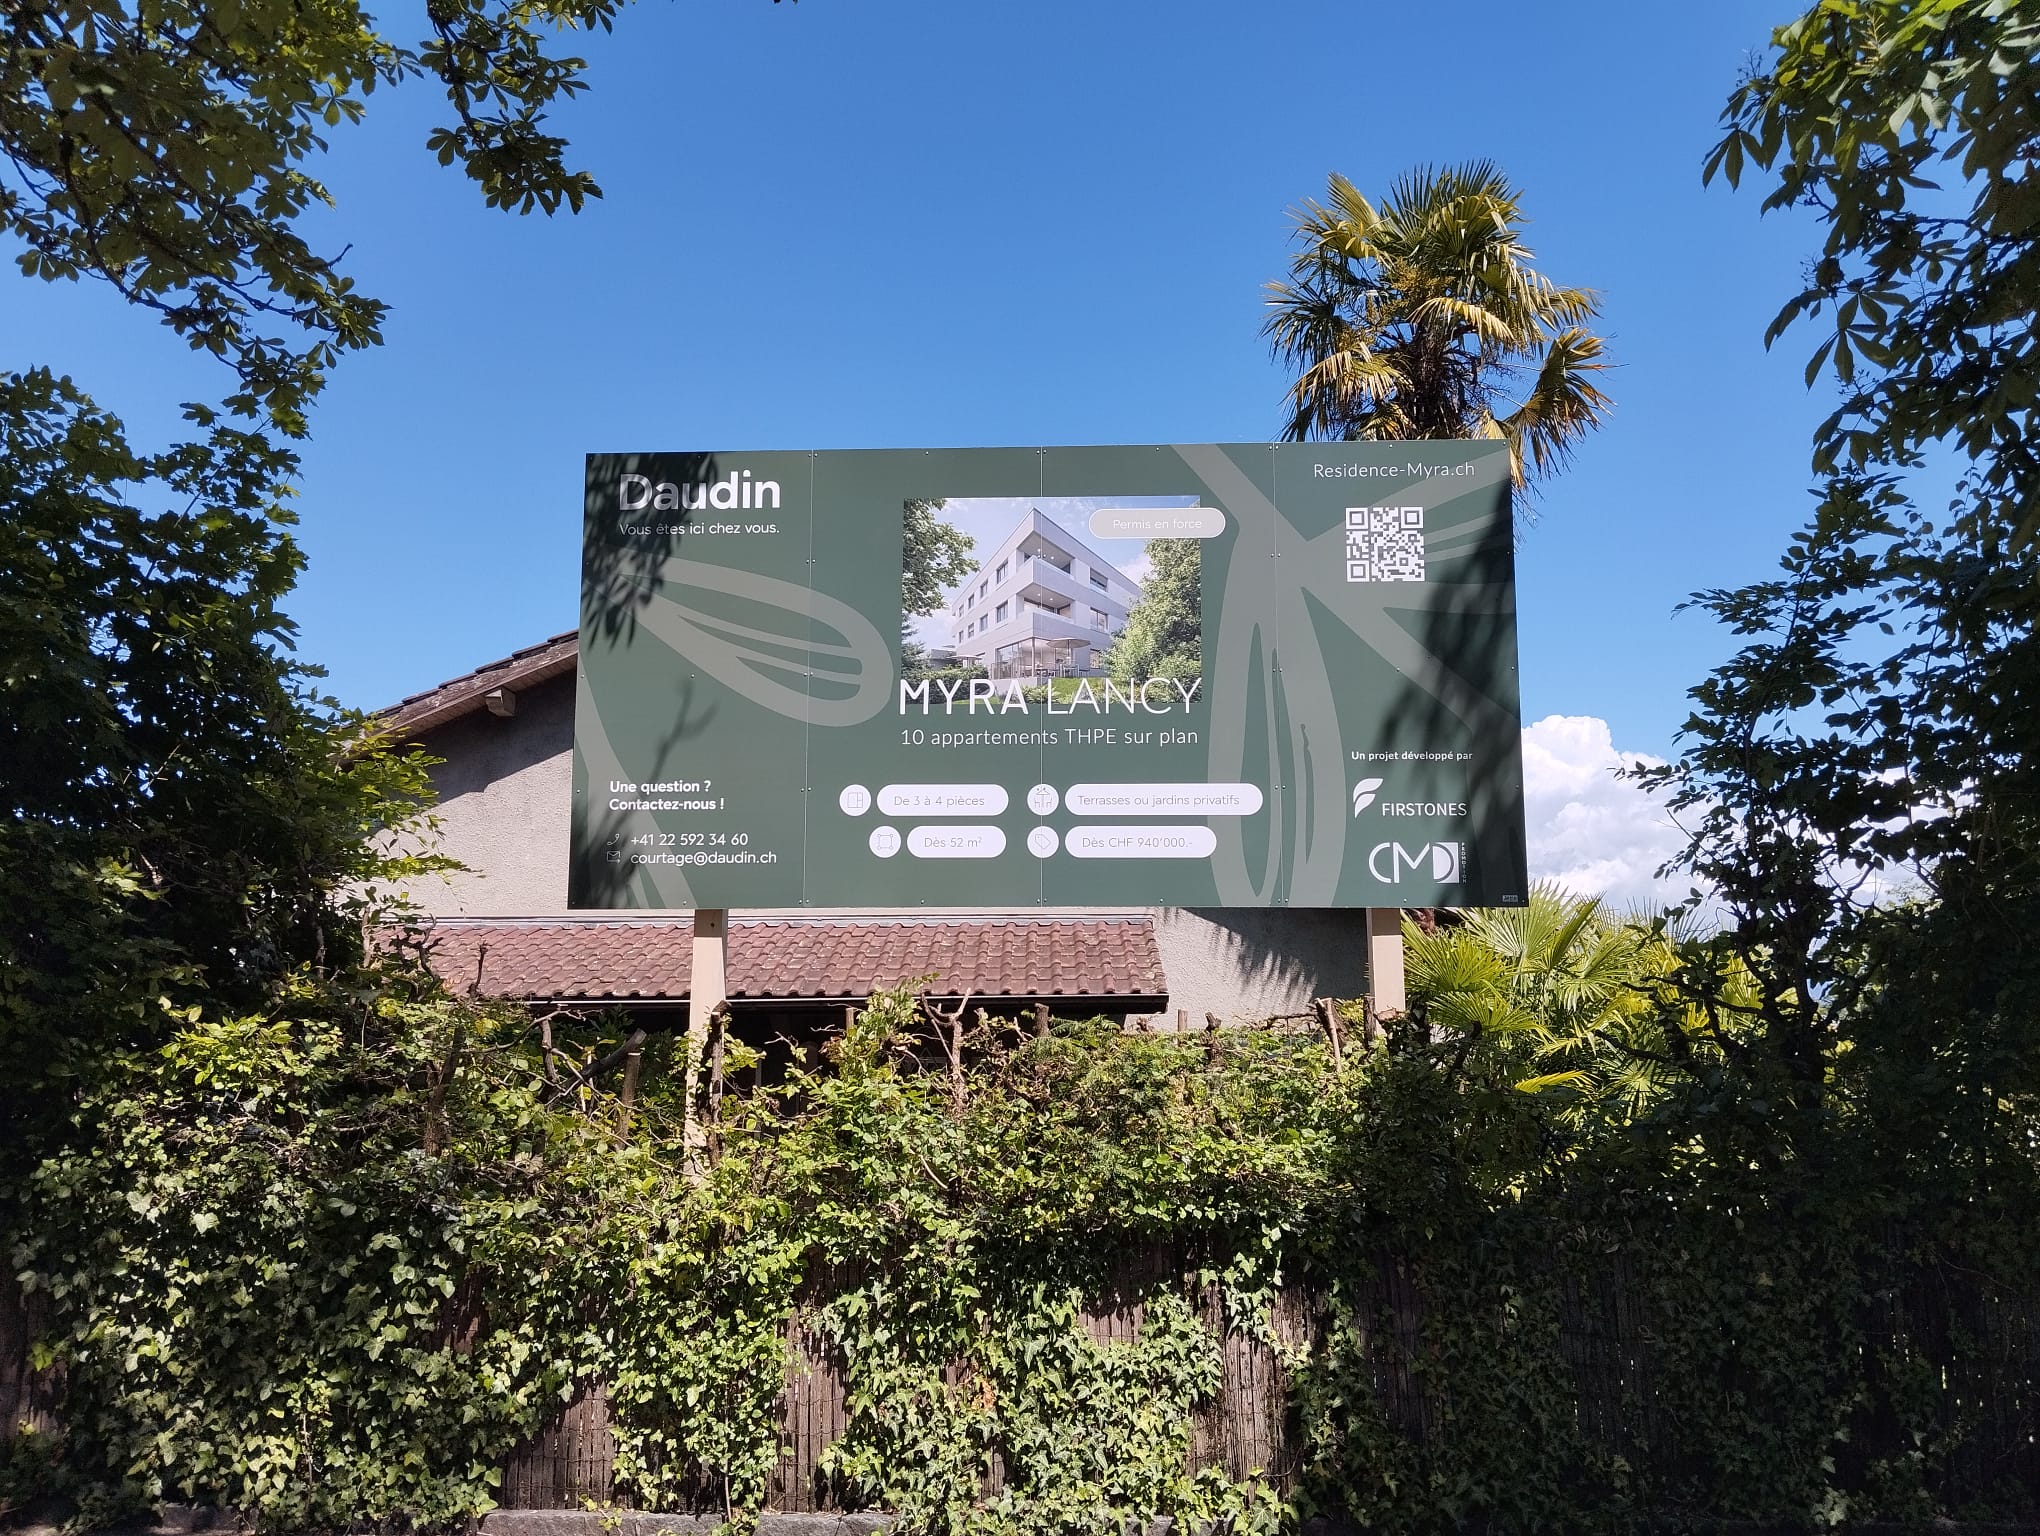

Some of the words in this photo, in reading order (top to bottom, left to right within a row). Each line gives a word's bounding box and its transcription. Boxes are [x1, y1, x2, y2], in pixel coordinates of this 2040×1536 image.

[1314, 462, 1475, 480] Residence-Myra.ch
[619, 469, 781, 511] Daudin
[619, 524, 651, 535] Vous
[656, 522, 685, 535] êtes
[690, 523, 704, 534] ici
[709, 522, 740, 534] chez
[745, 523, 780, 534] vous.
[1113, 520, 1150, 529] Permis
[1173, 519, 1202, 528] force
[900, 679, 1029, 715] MYRA
[1048, 678, 1202, 714] LANCY
[901, 730, 924, 745] 10
[931, 729, 1058, 748] appartements
[1065, 728, 1116, 744] THPE
[1124, 732, 1152, 744] sur
[1160, 728, 1198, 747] plan
[1352, 751, 1365, 760] Un
[1369, 751, 1399, 761] projet
[1402, 751, 1453, 761] développé
[1457, 752, 1472, 761] par
[609, 781, 637, 793] Une
[641, 780, 699, 795] question
[704, 780, 711, 792] ?
[609, 799, 716, 810] Contactez-nous
[720, 798, 724, 810] !
[894, 796, 909, 805] De
[914, 796, 919, 805] 3
[924, 795, 931, 805] à
[935, 796, 942, 805] 4
[947, 795, 985, 808] pièces
[1077, 795, 1130, 805] Terrasses
[1134, 797, 1149, 805] ou
[1151, 795, 1189, 807] jardins
[1193, 795, 1239, 807] privatifs
[1382, 803, 1467, 817] FIRSTONES
[631, 834, 654, 846] +41
[659, 834, 675, 845] 22
[680, 834, 704, 845] 592
[709, 834, 726, 845] 34
[731, 833, 748, 845] 60
[924, 836, 946, 848] Dès
[950, 837, 964, 848] 52
[1082, 837, 1104, 848] Dès
[1108, 838, 1132, 848] CHF
[630, 851, 777, 866] courtage@daudin.ch
[1369, 842, 1459, 884] CMD
